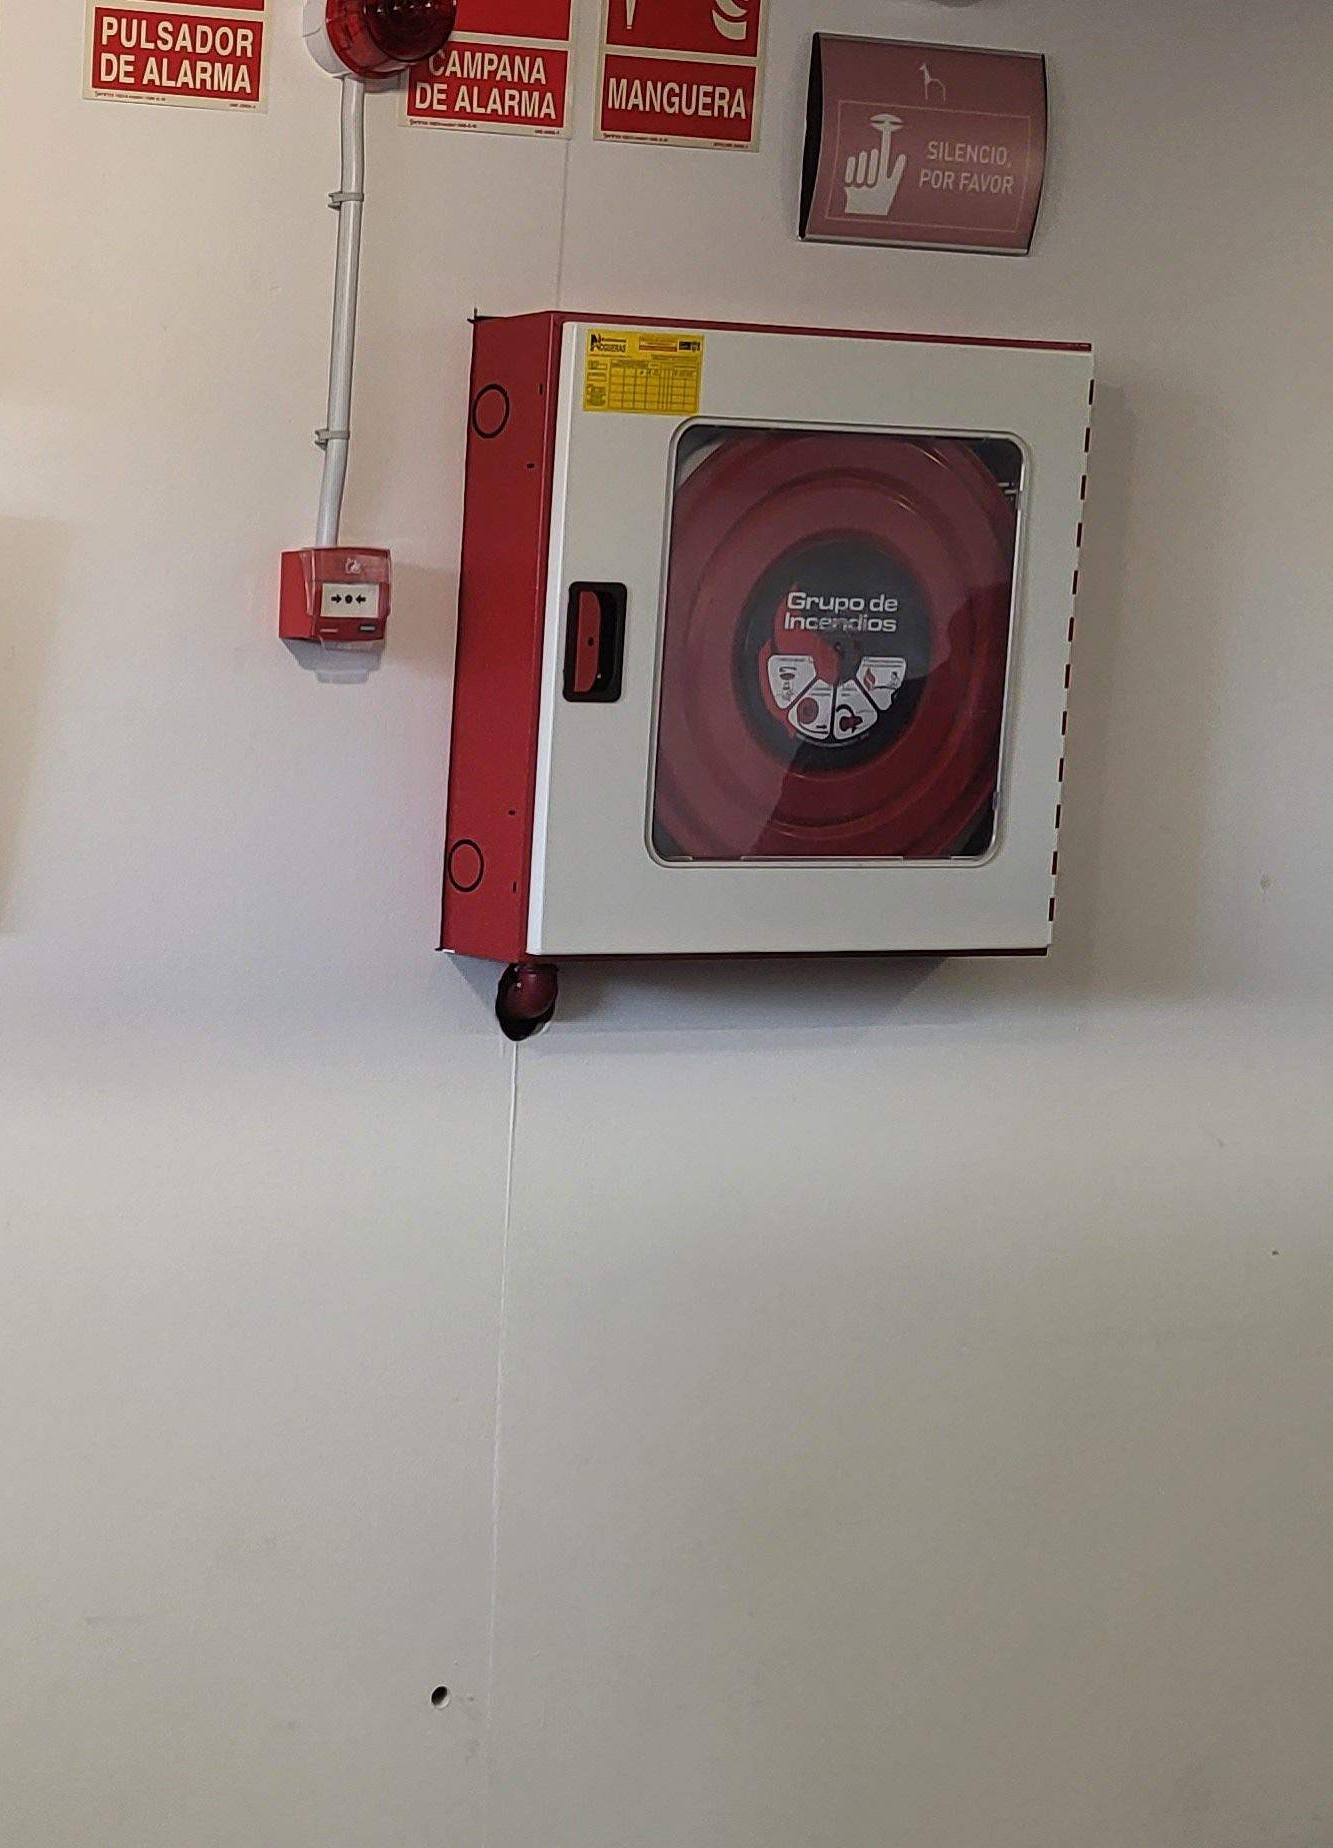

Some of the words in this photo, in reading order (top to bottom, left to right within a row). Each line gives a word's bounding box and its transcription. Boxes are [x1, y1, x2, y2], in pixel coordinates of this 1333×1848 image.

[101, 16, 254, 58] PULSADOR
[100, 52, 136, 84] DE
[142, 56, 252, 94] ALARMA
[428, 49, 547, 85] CAMPANA
[415, 81, 448, 111] DE
[454, 84, 557, 120] ALARMA
[607, 77, 747, 120] MANGUERA
[926, 140, 1012, 168] SILENCIO,
[919, 168, 955, 190] POR
[959, 172, 1014, 194] FAVOR
[787, 591, 865, 614] Grupo
[869, 594, 898, 612] de
[784, 612, 897, 632] Incendios
